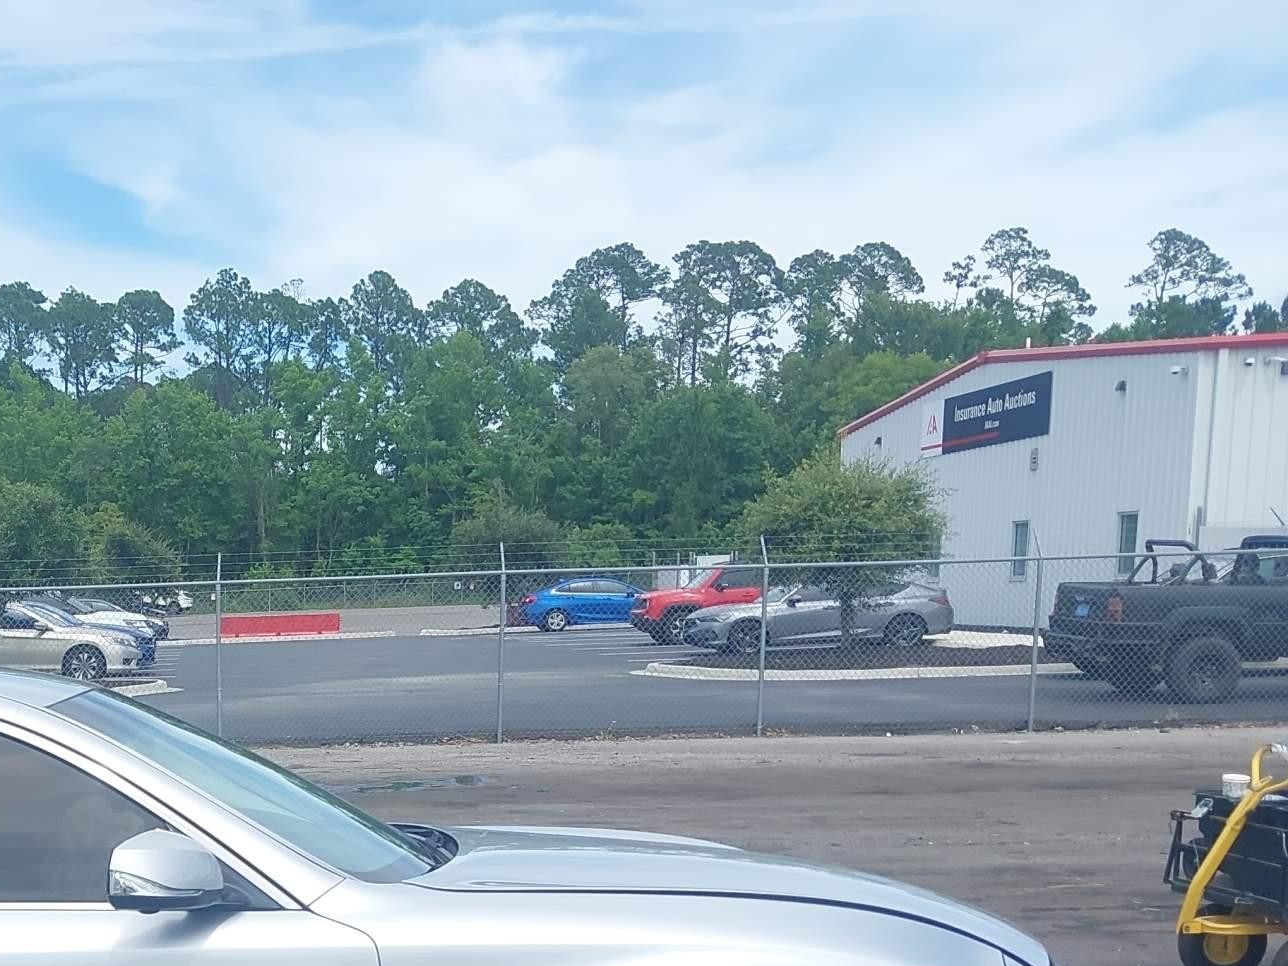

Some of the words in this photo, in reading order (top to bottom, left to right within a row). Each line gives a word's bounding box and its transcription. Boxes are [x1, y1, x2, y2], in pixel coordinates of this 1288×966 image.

[954, 404, 986, 423] Insurance
[987, 397, 1003, 415] Auto
[1004, 389, 1037, 411] Auctions
